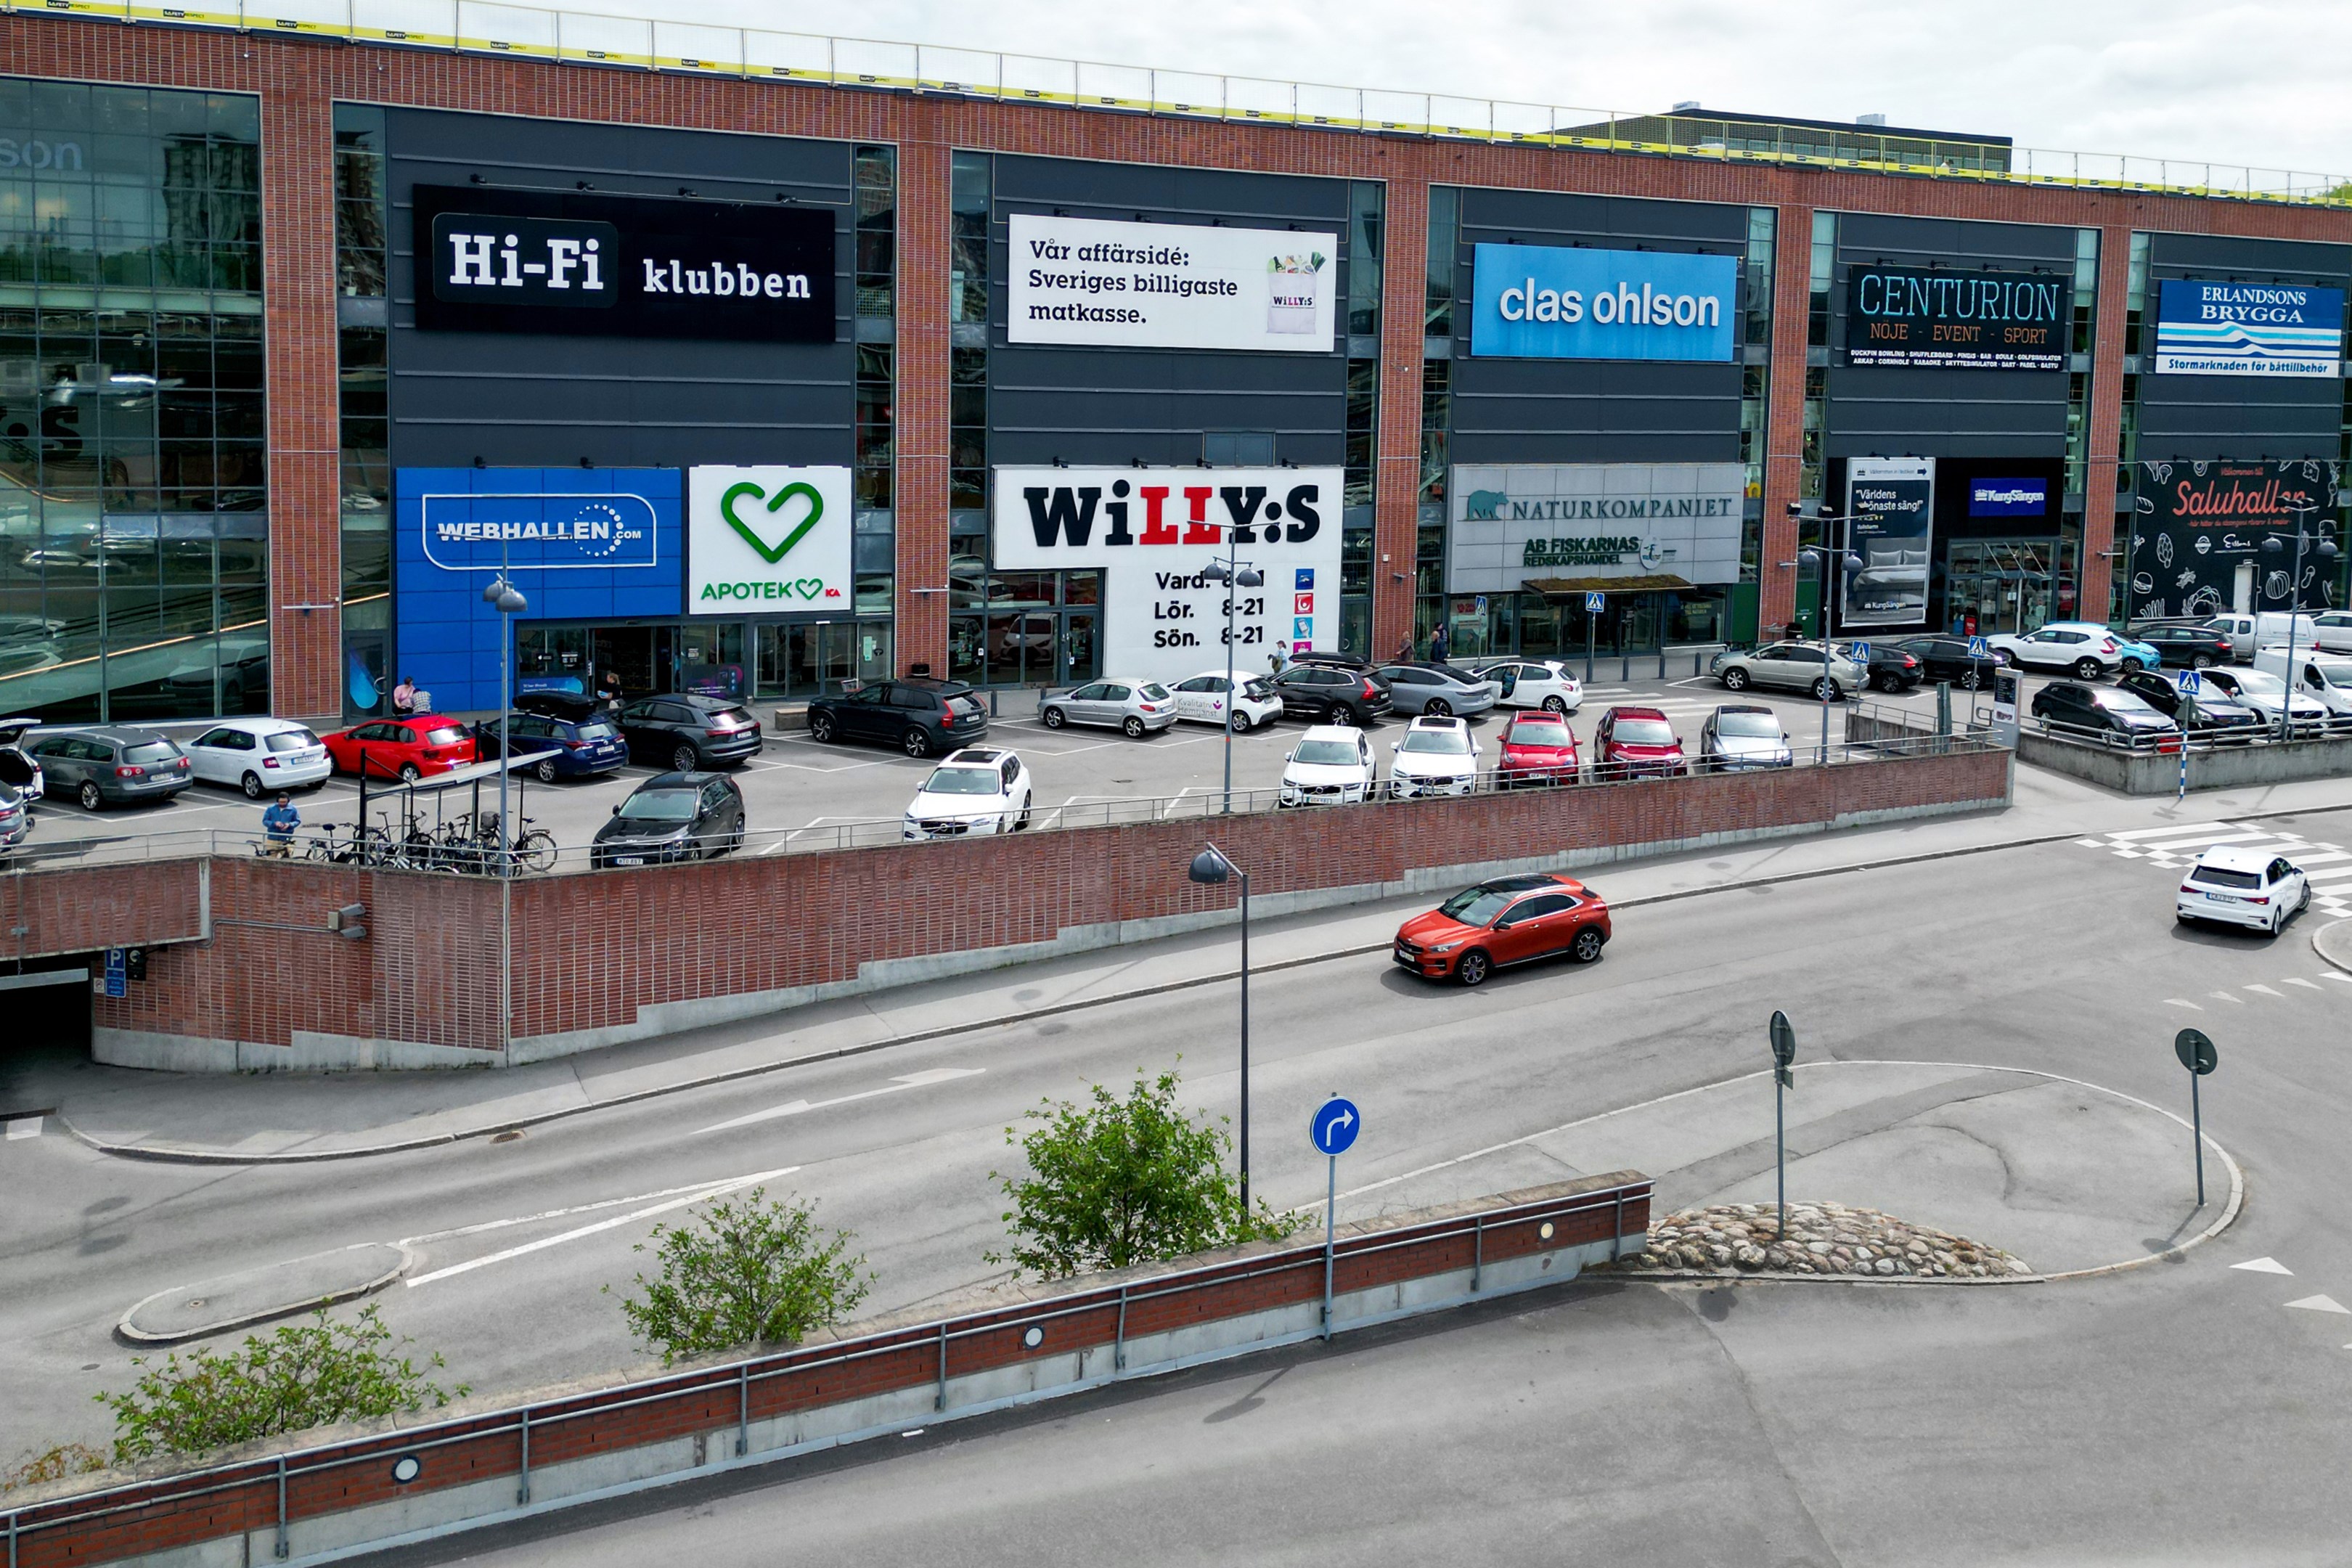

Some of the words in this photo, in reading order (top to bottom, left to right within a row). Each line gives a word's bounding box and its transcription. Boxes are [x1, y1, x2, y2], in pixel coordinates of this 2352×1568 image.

[1029, 238, 1071, 262] Vår
[1077, 243, 1190, 266] affärsidé:
[449, 233, 604, 290] Hi-Fi
[642, 258, 811, 298] klubben
[1029, 269, 1127, 293] Sveriges
[1133, 273, 1238, 298] billigaste
[1500, 277, 1583, 324] clas
[1593, 281, 1720, 327] ohlson
[1860, 274, 2059, 322] CENTURION
[2202, 287, 2306, 306] ERLANDSONS
[1029, 303, 1148, 324] matkasse.
[2201, 305, 2304, 323] BRYGGA
[1870, 319, 1908, 340] NÖJE
[1932, 324, 1981, 342] EVENT
[2004, 327, 2048, 344] SPORT
[2168, 359, 2247, 371] Stormarknaden
[2252, 360, 2266, 372] för
[2269, 361, 2328, 373] båttillbehör
[1857, 500, 1895, 511] önaste
[1988, 489, 2044, 504] KungSängen
[1024, 478, 1320, 547] WiLLY:S
[1512, 498, 1733, 520] NATURKOMPANIET
[1524, 539, 1547, 553] AB
[1551, 537, 1640, 552] FISKARNAS
[1523, 555, 1622, 567] REDSKAPSHANDEL
[700, 581, 793, 600] APOTEK
[825, 588, 841, 597] ICA
[1155, 572, 1211, 591] Vard.
[1155, 600, 1194, 619] Lör.
[1222, 597, 1264, 617] 8-21
[1154, 629, 1200, 648] Sön.
[1221, 626, 1262, 645] 8-21
